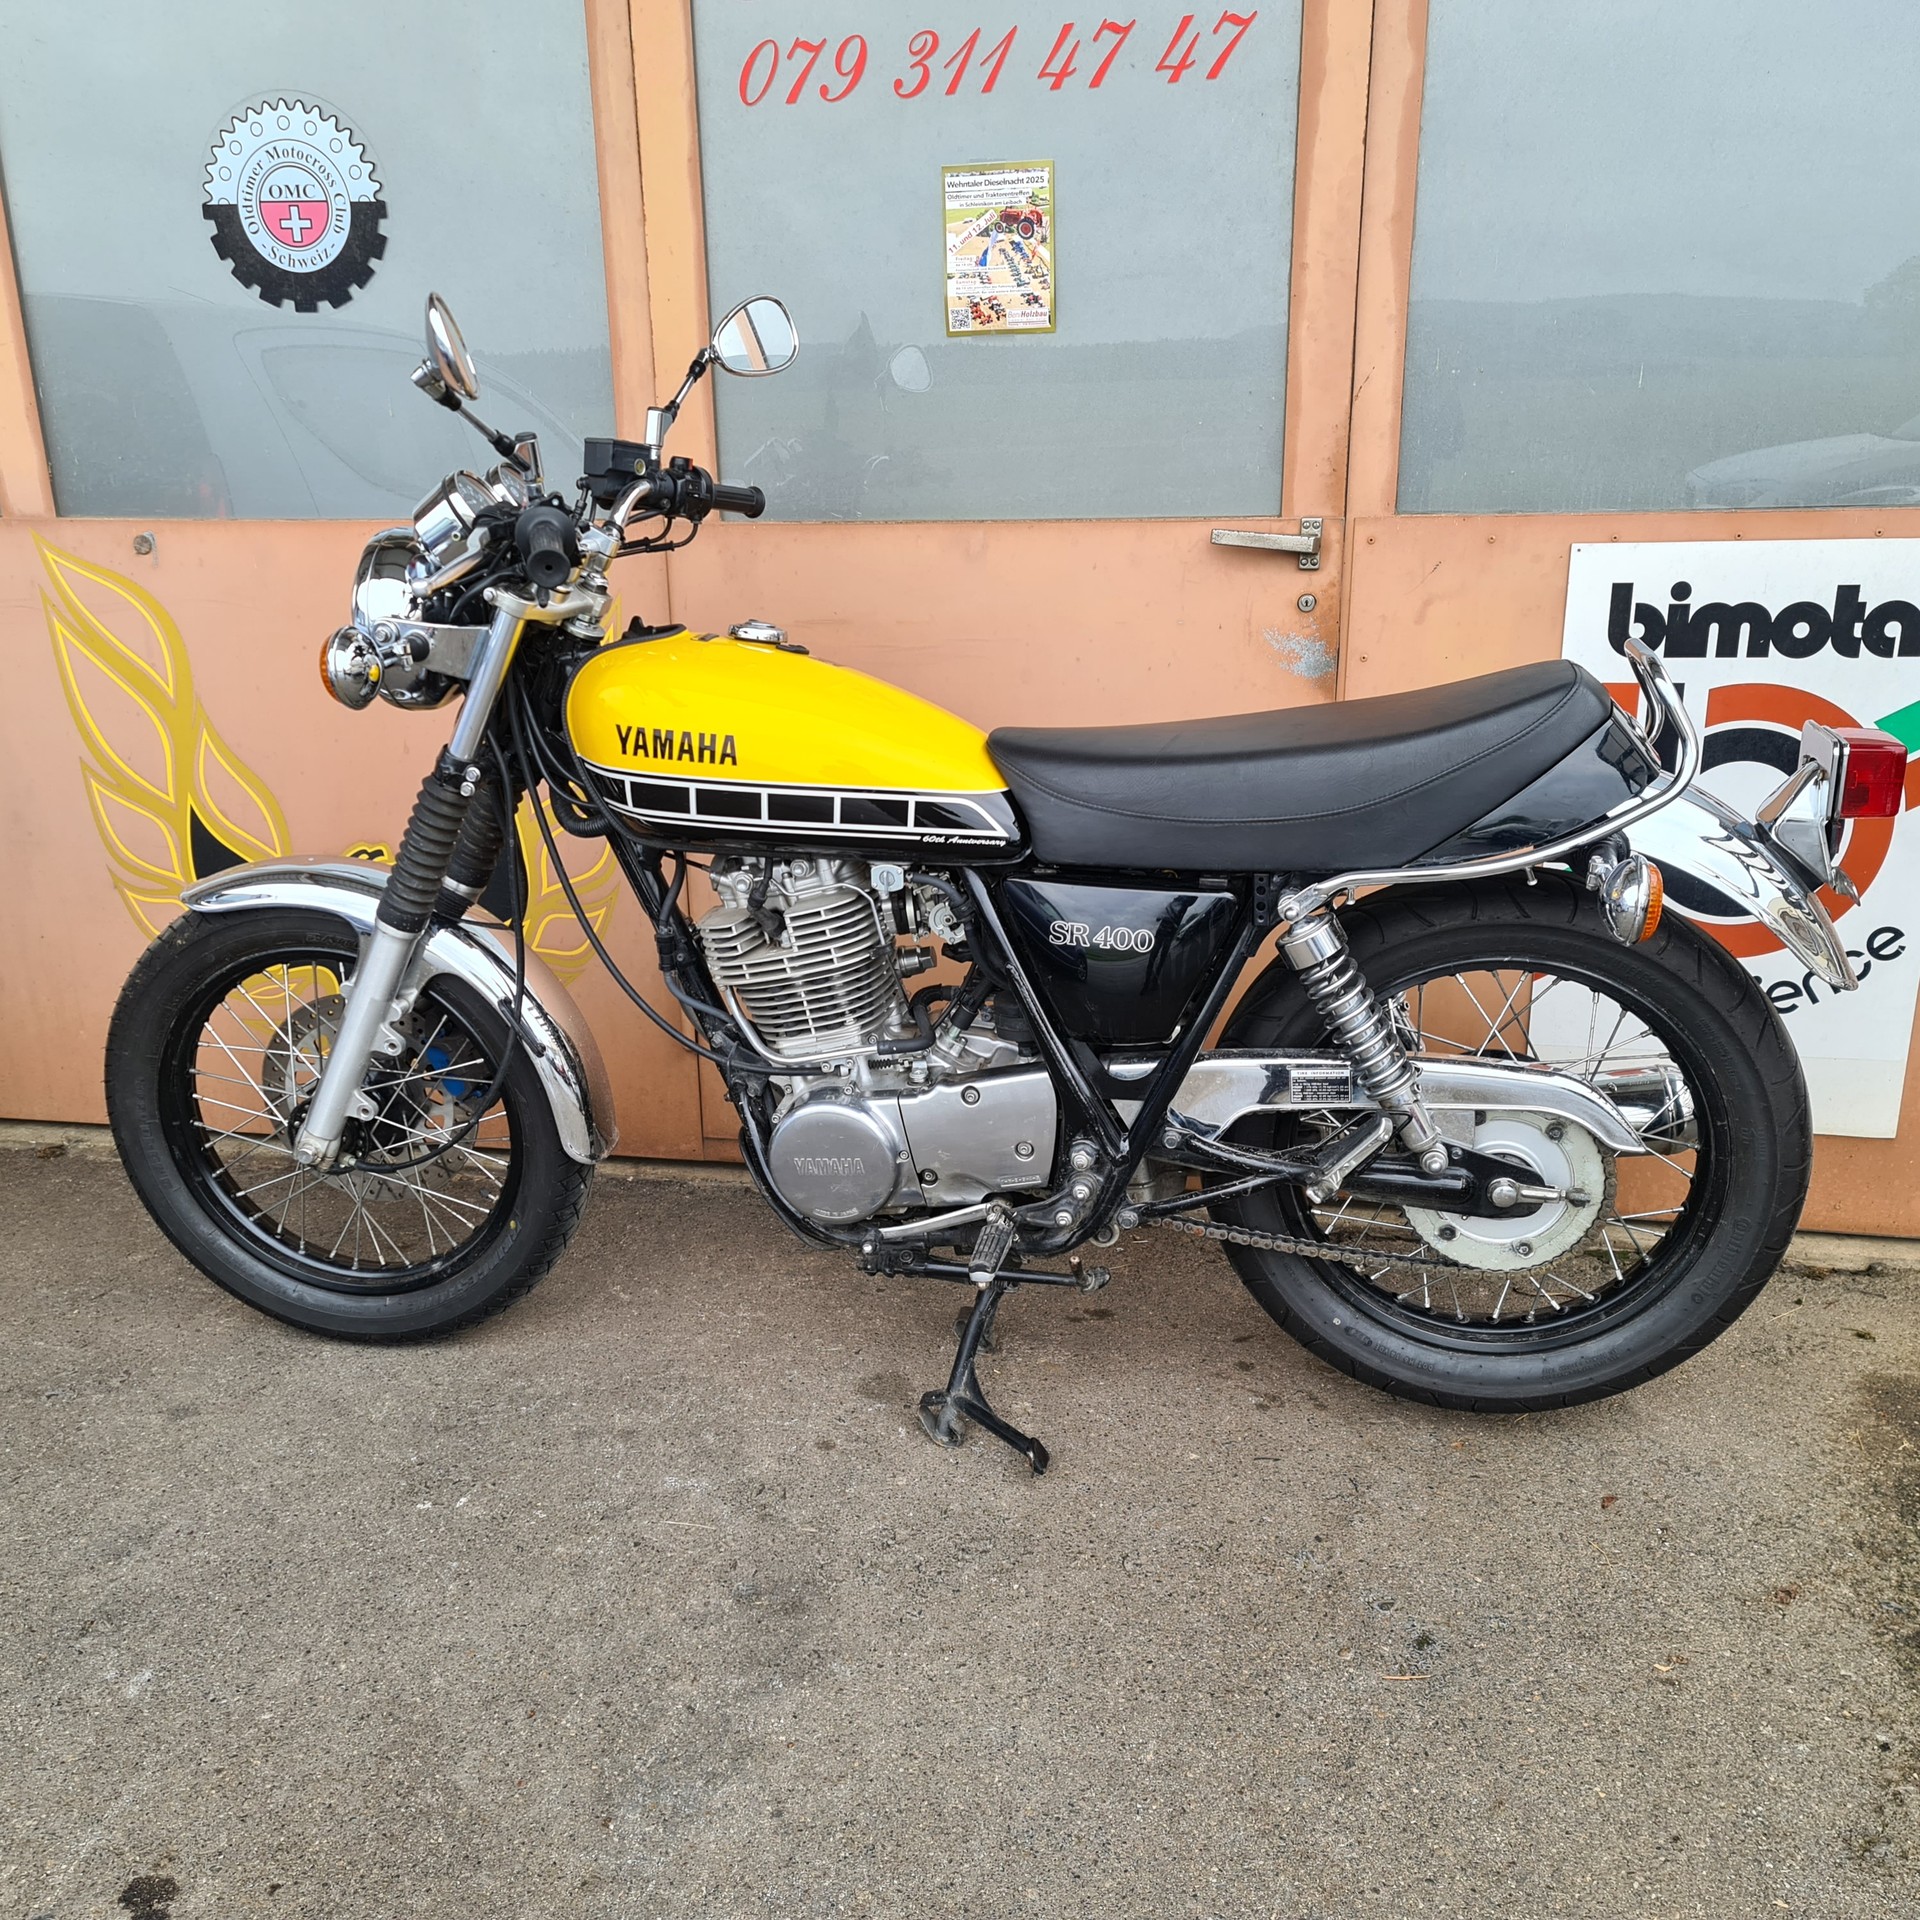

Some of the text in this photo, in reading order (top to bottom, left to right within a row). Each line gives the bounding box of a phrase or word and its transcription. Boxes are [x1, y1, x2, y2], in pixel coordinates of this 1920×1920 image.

[739, 10, 1258, 107] 079 311 47 47
[242, 146, 347, 235] Oldtimer Motocross Club
[268, 184, 316, 199] OMC
[946, 176, 1045, 189] Wehntaler Dieselnacht 2025
[985, 190, 1030, 198] Traktorentreffen
[960, 230, 973, 245] und
[984, 212, 996, 226] Juli
[268, 245, 332, 268] Schweiz
[1607, 581, 1920, 659] bimota
[615, 723, 738, 766] YAMAHA
[922, 835, 1007, 847] 60th Anniversary
[1049, 920, 1155, 953] SR 400
[793, 1157, 866, 1177] YAMAHA
